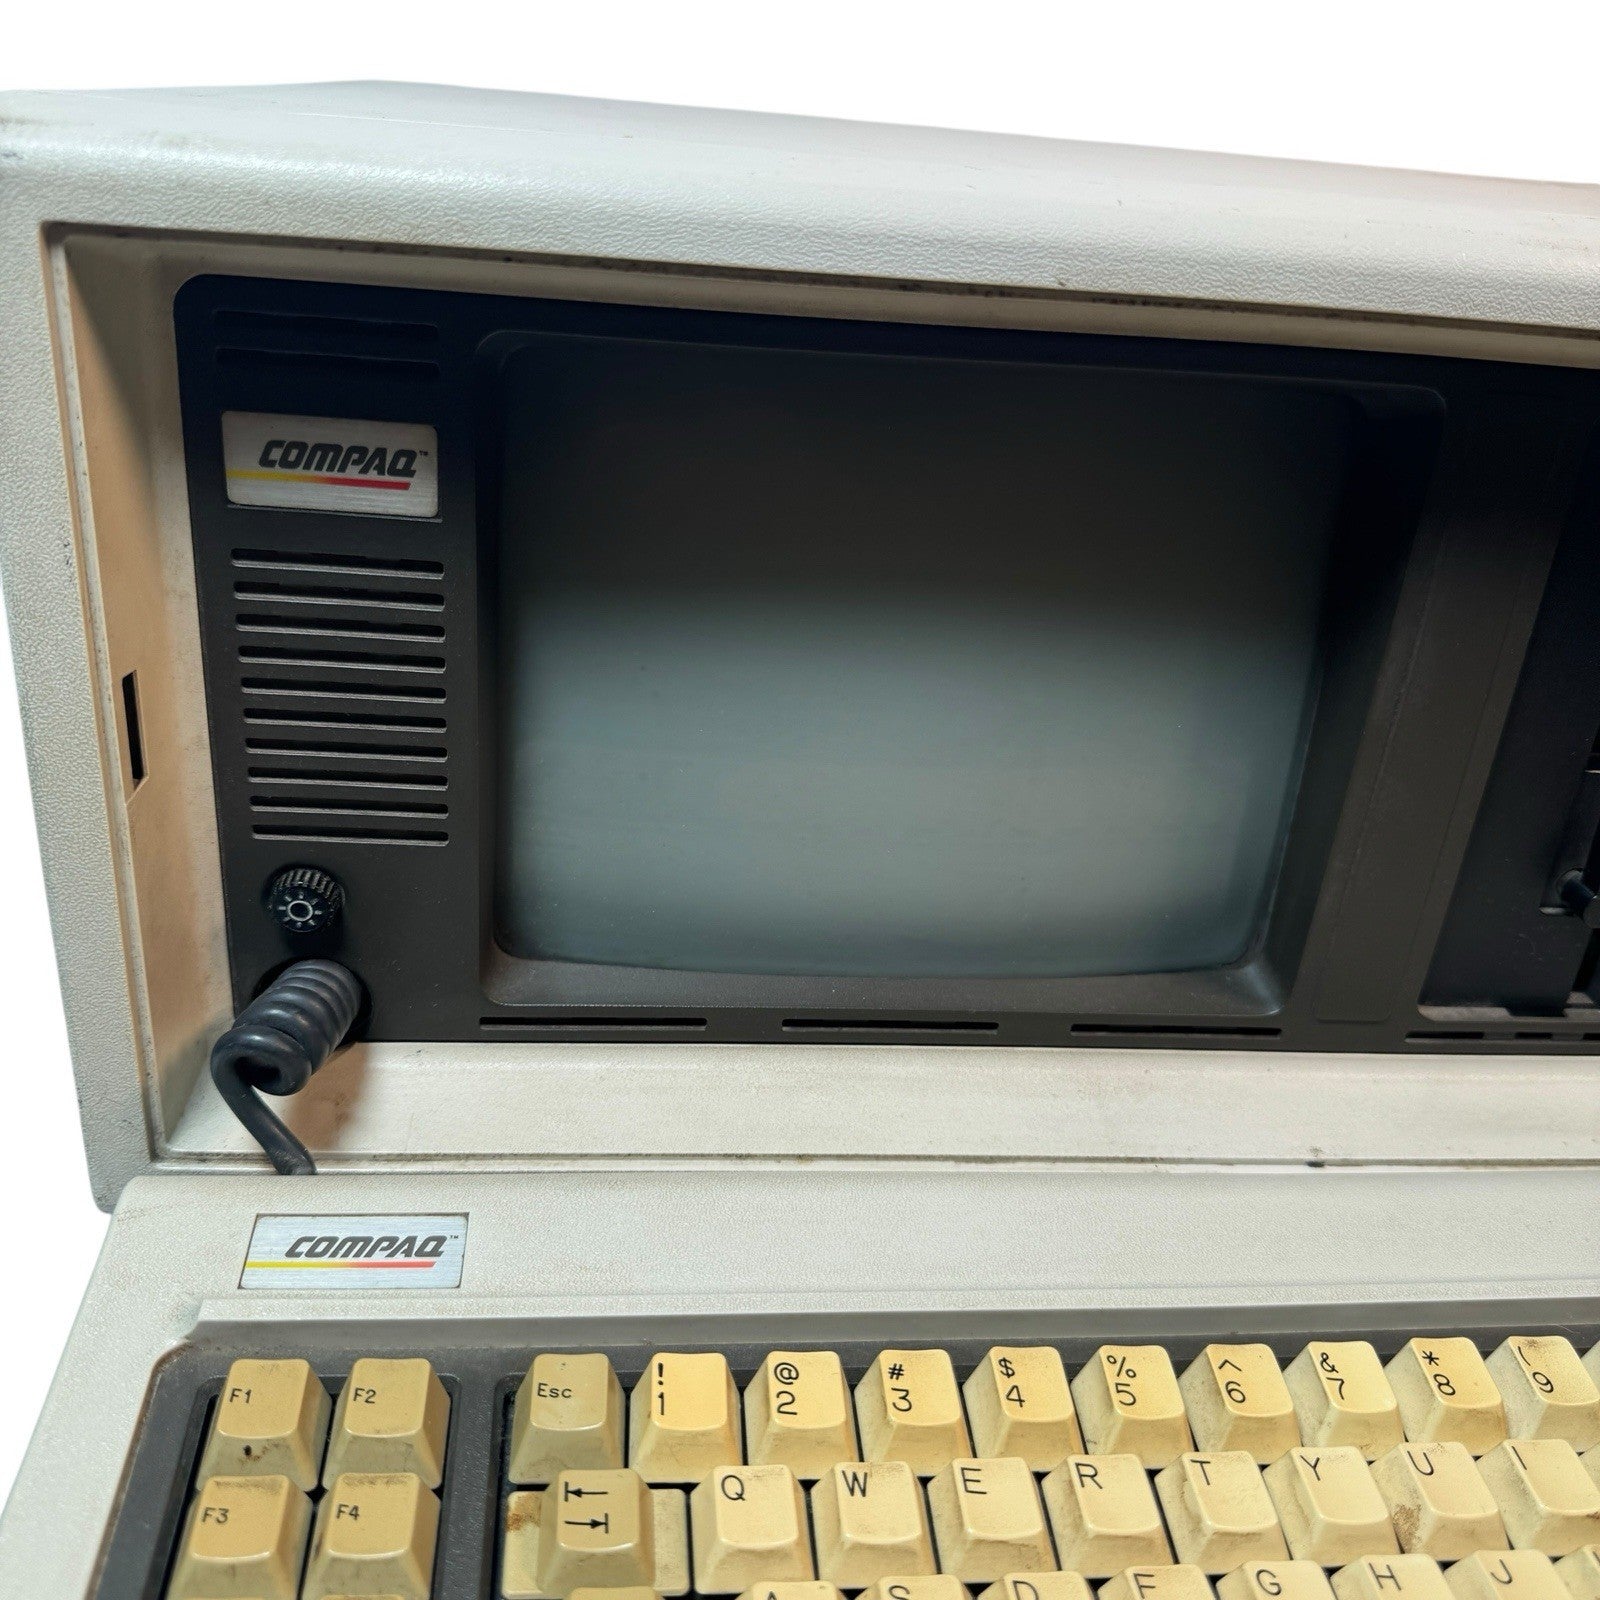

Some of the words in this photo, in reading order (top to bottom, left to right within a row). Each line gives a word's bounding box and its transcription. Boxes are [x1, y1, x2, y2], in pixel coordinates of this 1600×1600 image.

[259, 440, 417, 478] COMPAQ
[285, 1236, 447, 1258] COMPAQ
[657, 1362, 665, 1386] !
[774, 1362, 799, 1385] @
[889, 1364, 904, 1380] #
[998, 1357, 1015, 1378] $
[1107, 1355, 1137, 1379] %
[1320, 1352, 1339, 1373] &
[538, 1383, 571, 1398] Esc
[1114, 1383, 1136, 1406] 5
[1226, 1383, 1246, 1403] 6
[1327, 1378, 1345, 1400] 7
[1433, 1374, 1456, 1396] 8
[1532, 1372, 1554, 1394] 9
[229, 1388, 251, 1404] F1
[353, 1388, 376, 1404] F2
[657, 1391, 666, 1416] 1
[776, 1391, 797, 1415] 2
[891, 1388, 912, 1412] 3
[1006, 1385, 1025, 1407] 4
[1191, 1459, 1211, 1486] T
[1300, 1455, 1321, 1481] Y
[1407, 1451, 1434, 1476] U
[721, 1475, 745, 1501] Q
[842, 1471, 868, 1497] W
[961, 1467, 987, 1495] E
[1075, 1463, 1102, 1490] R
[202, 1508, 228, 1524] F3
[336, 1504, 359, 1520] F4
[1256, 1569, 1282, 1596] G
[1369, 1563, 1401, 1591] H
[1490, 1559, 1513, 1585] J
[1134, 1573, 1156, 1599] F
